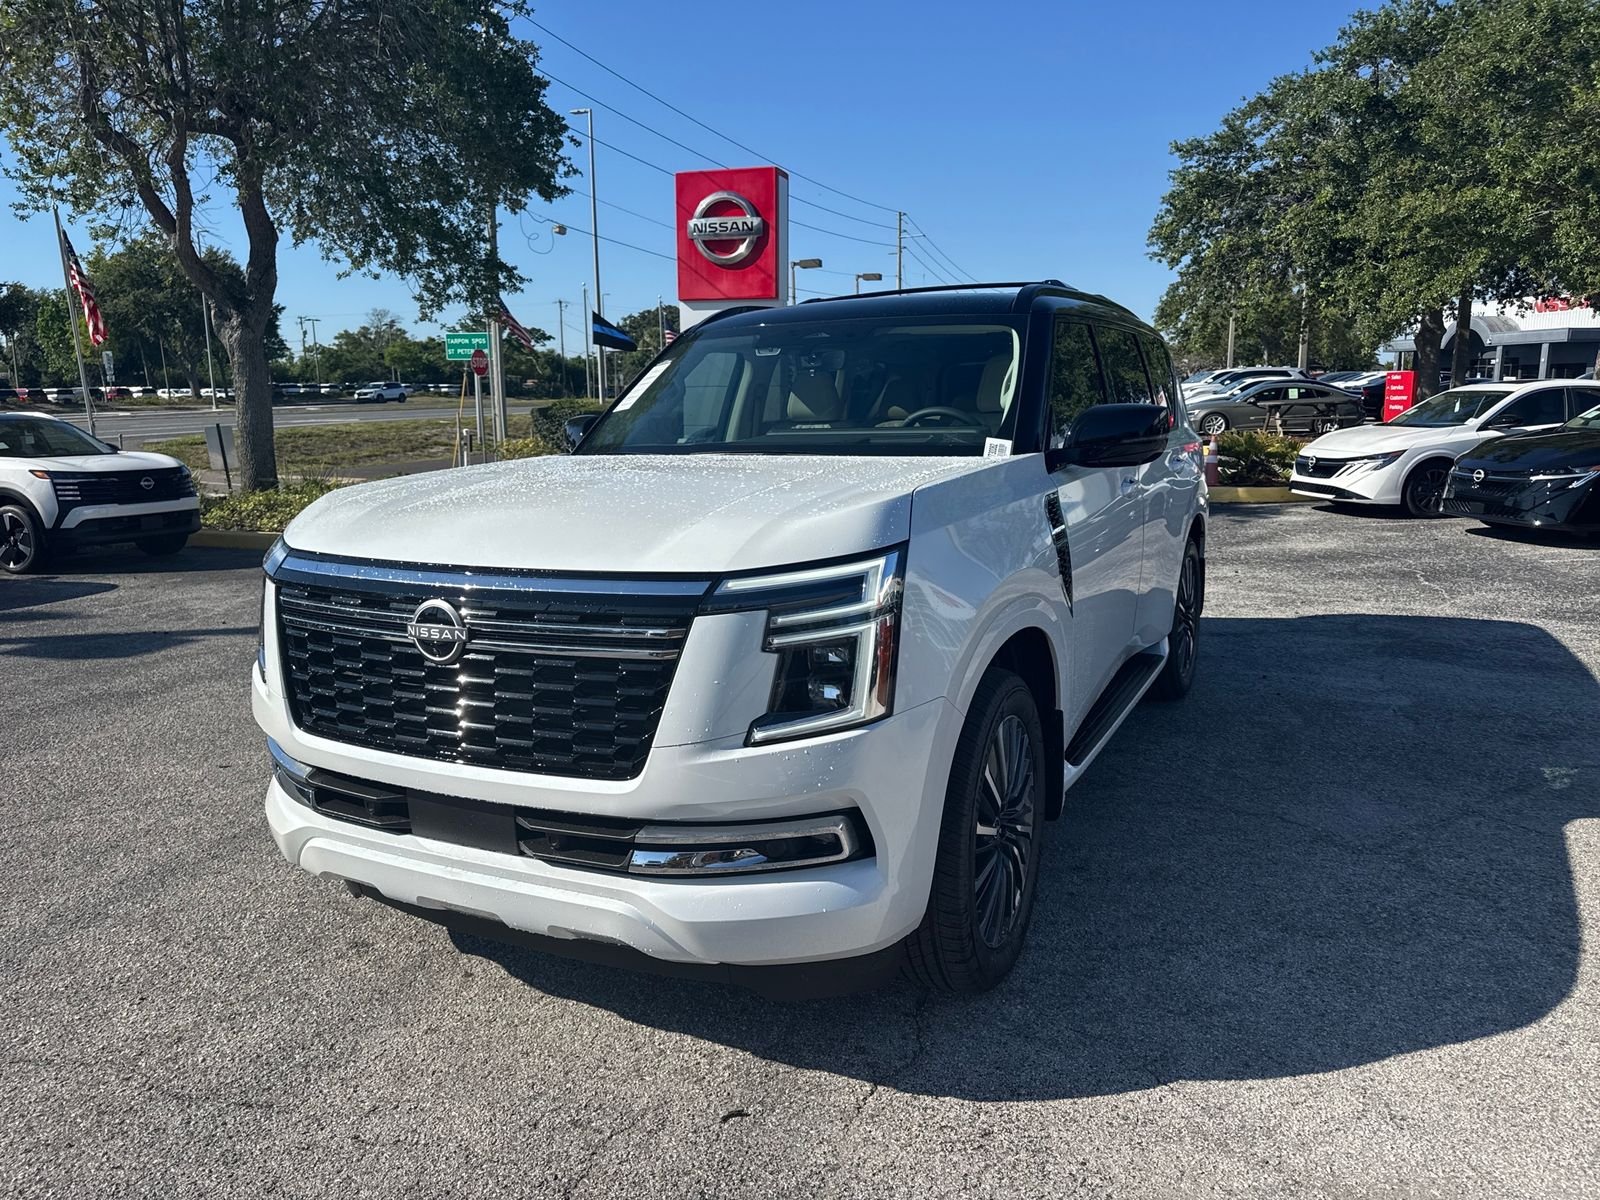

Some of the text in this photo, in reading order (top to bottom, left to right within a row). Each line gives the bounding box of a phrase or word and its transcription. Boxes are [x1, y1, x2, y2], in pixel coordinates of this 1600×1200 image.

[693, 221, 754, 233] NISSAN
[472, 357, 488, 368] STOP
[408, 625, 467, 640] NISSAN
